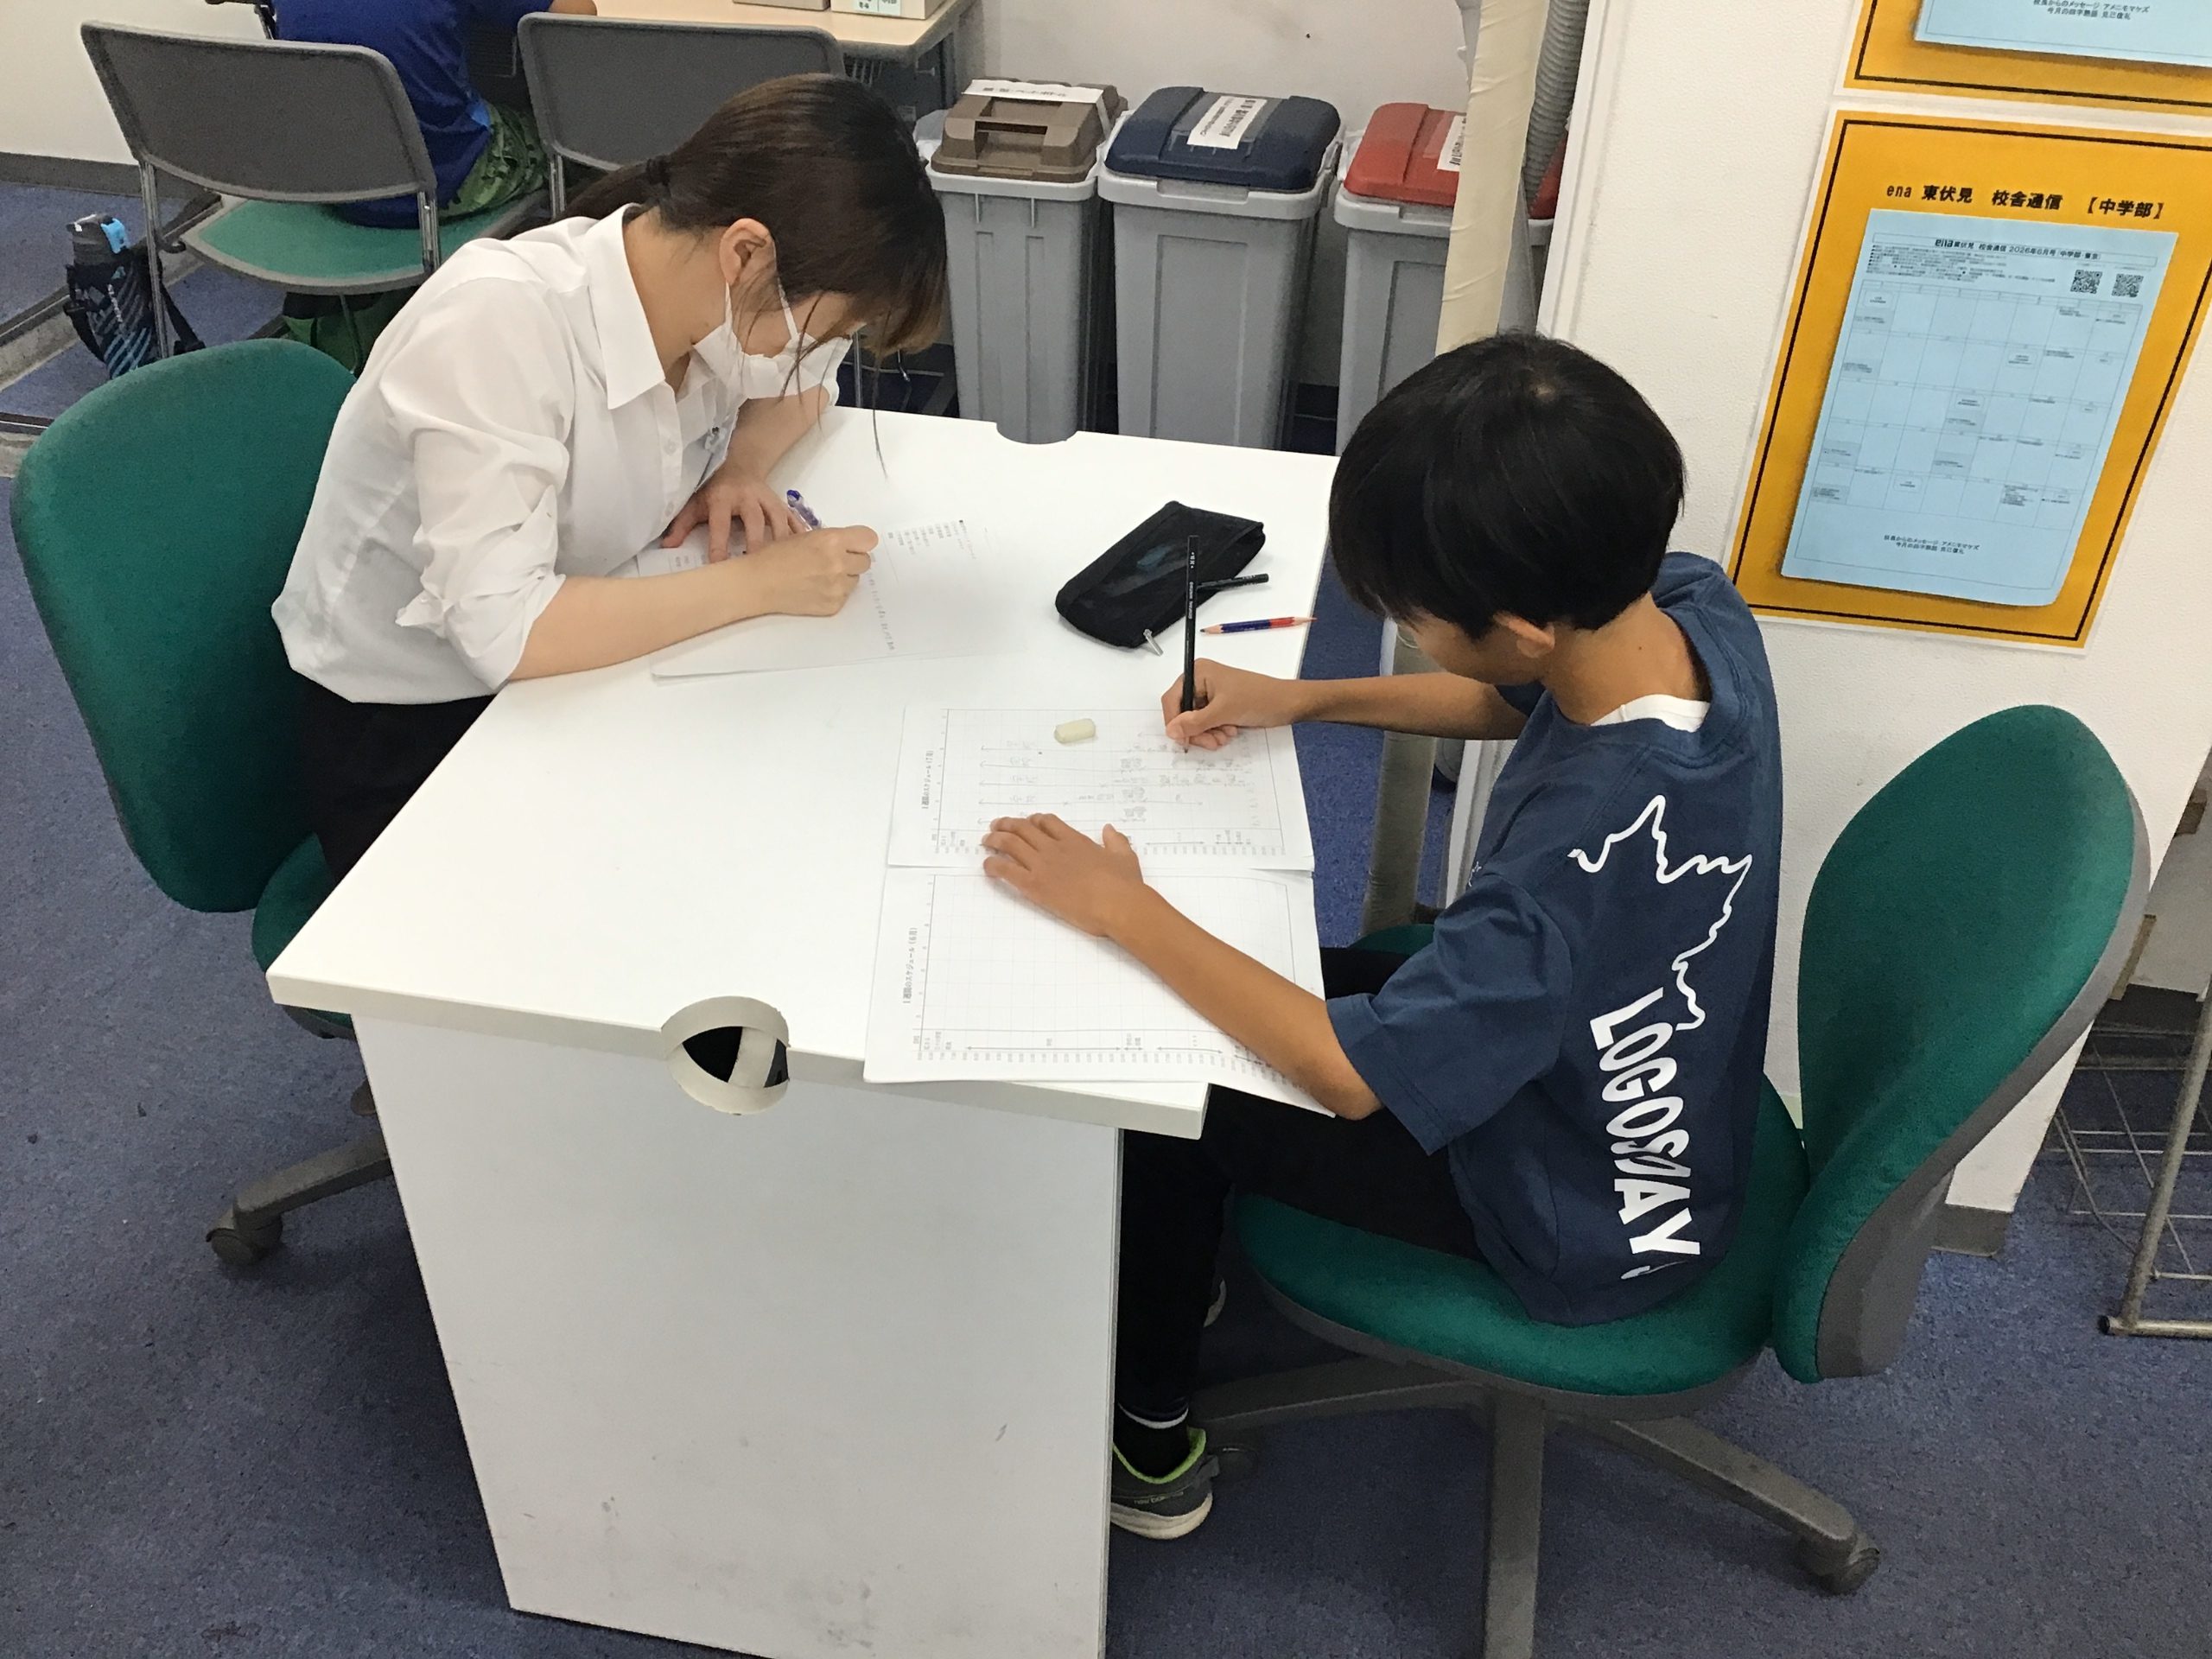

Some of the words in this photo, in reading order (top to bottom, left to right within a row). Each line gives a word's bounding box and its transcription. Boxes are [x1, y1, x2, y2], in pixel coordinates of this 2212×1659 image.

[1886, 185, 1912, 198] ena
[1922, 185, 1973, 203] 東伏見
[1992, 189, 2063, 210] 校舎通信
[2088, 196, 2164, 219] 【中学部】
